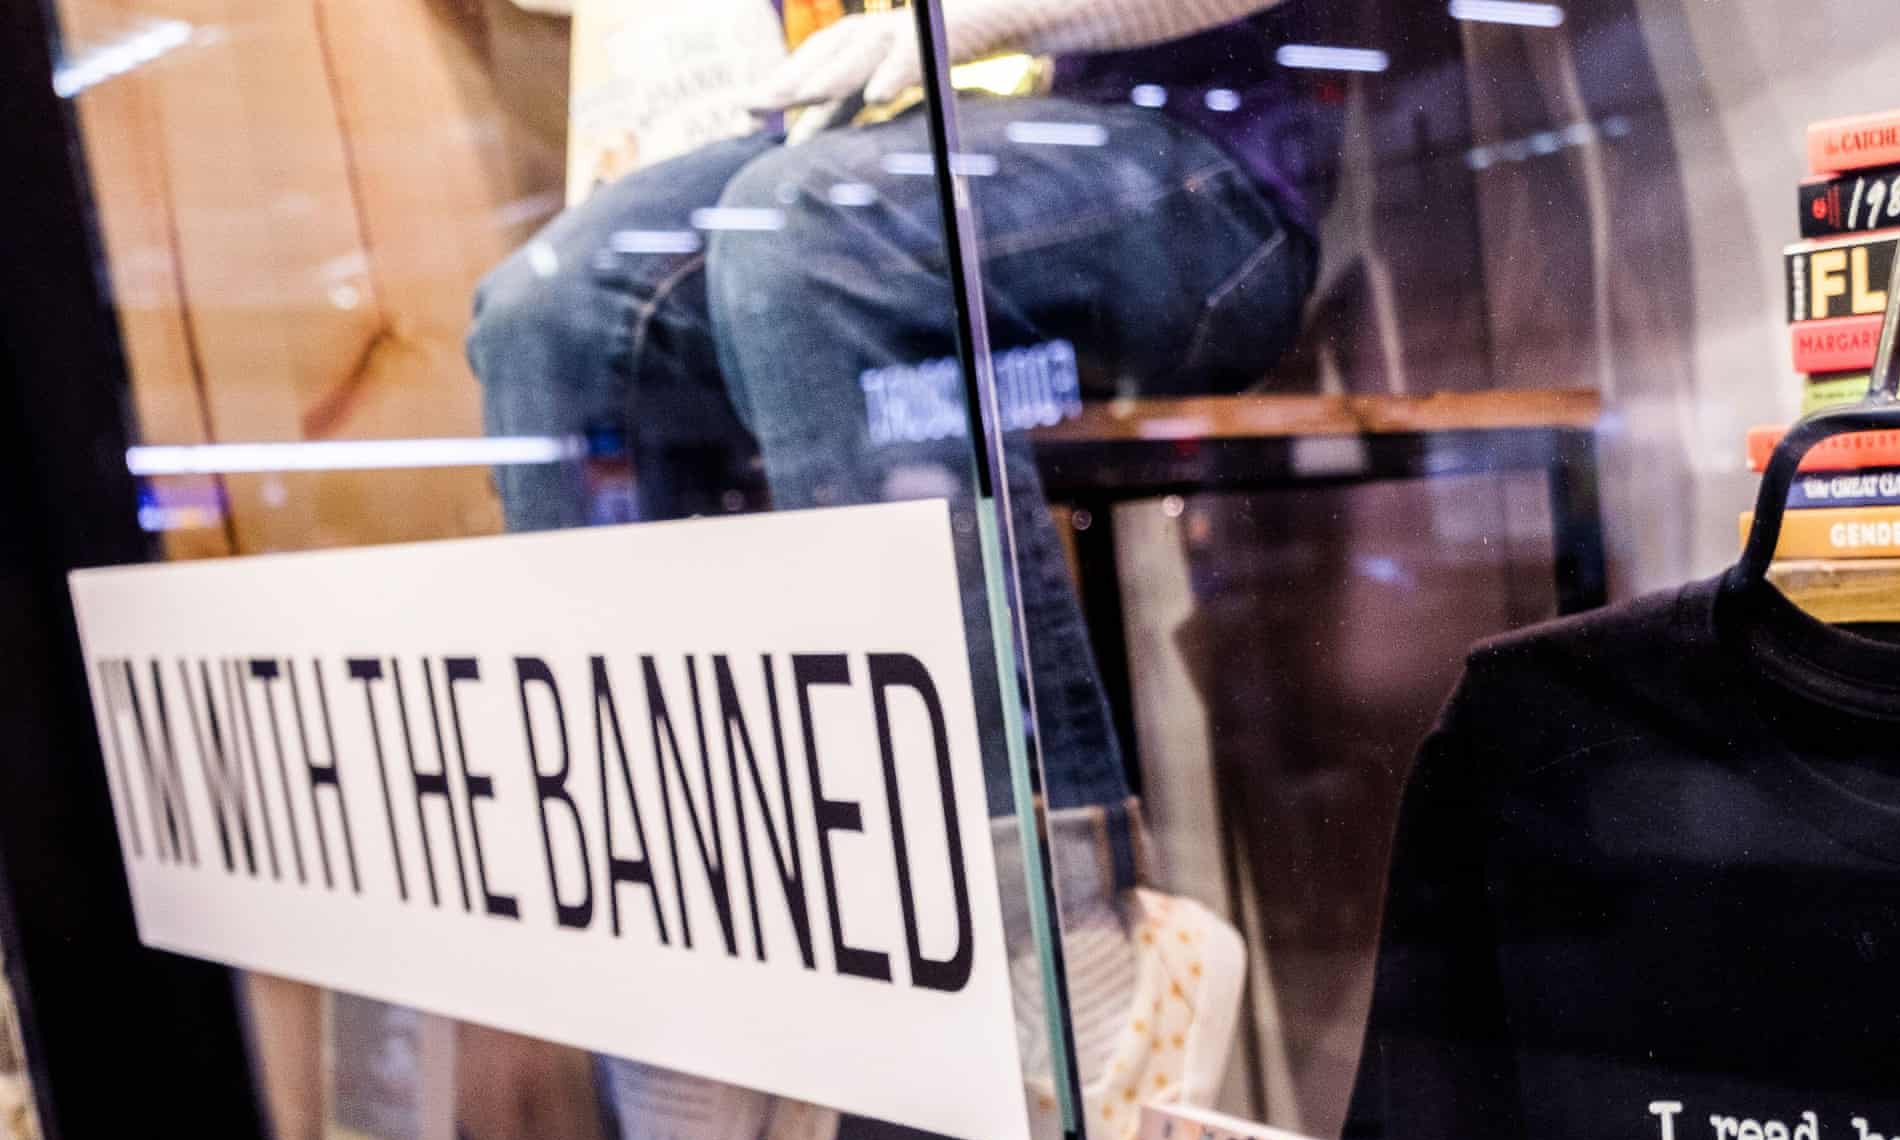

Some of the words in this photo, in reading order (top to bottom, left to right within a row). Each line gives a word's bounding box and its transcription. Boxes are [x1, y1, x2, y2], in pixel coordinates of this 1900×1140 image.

[1800, 329, 1878, 354] MARGAR
[1831, 476, 1877, 498] GREAT
[177, 657, 361, 895] WITH
[346, 655, 519, 921] THE
[512, 652, 974, 993] BANNED
